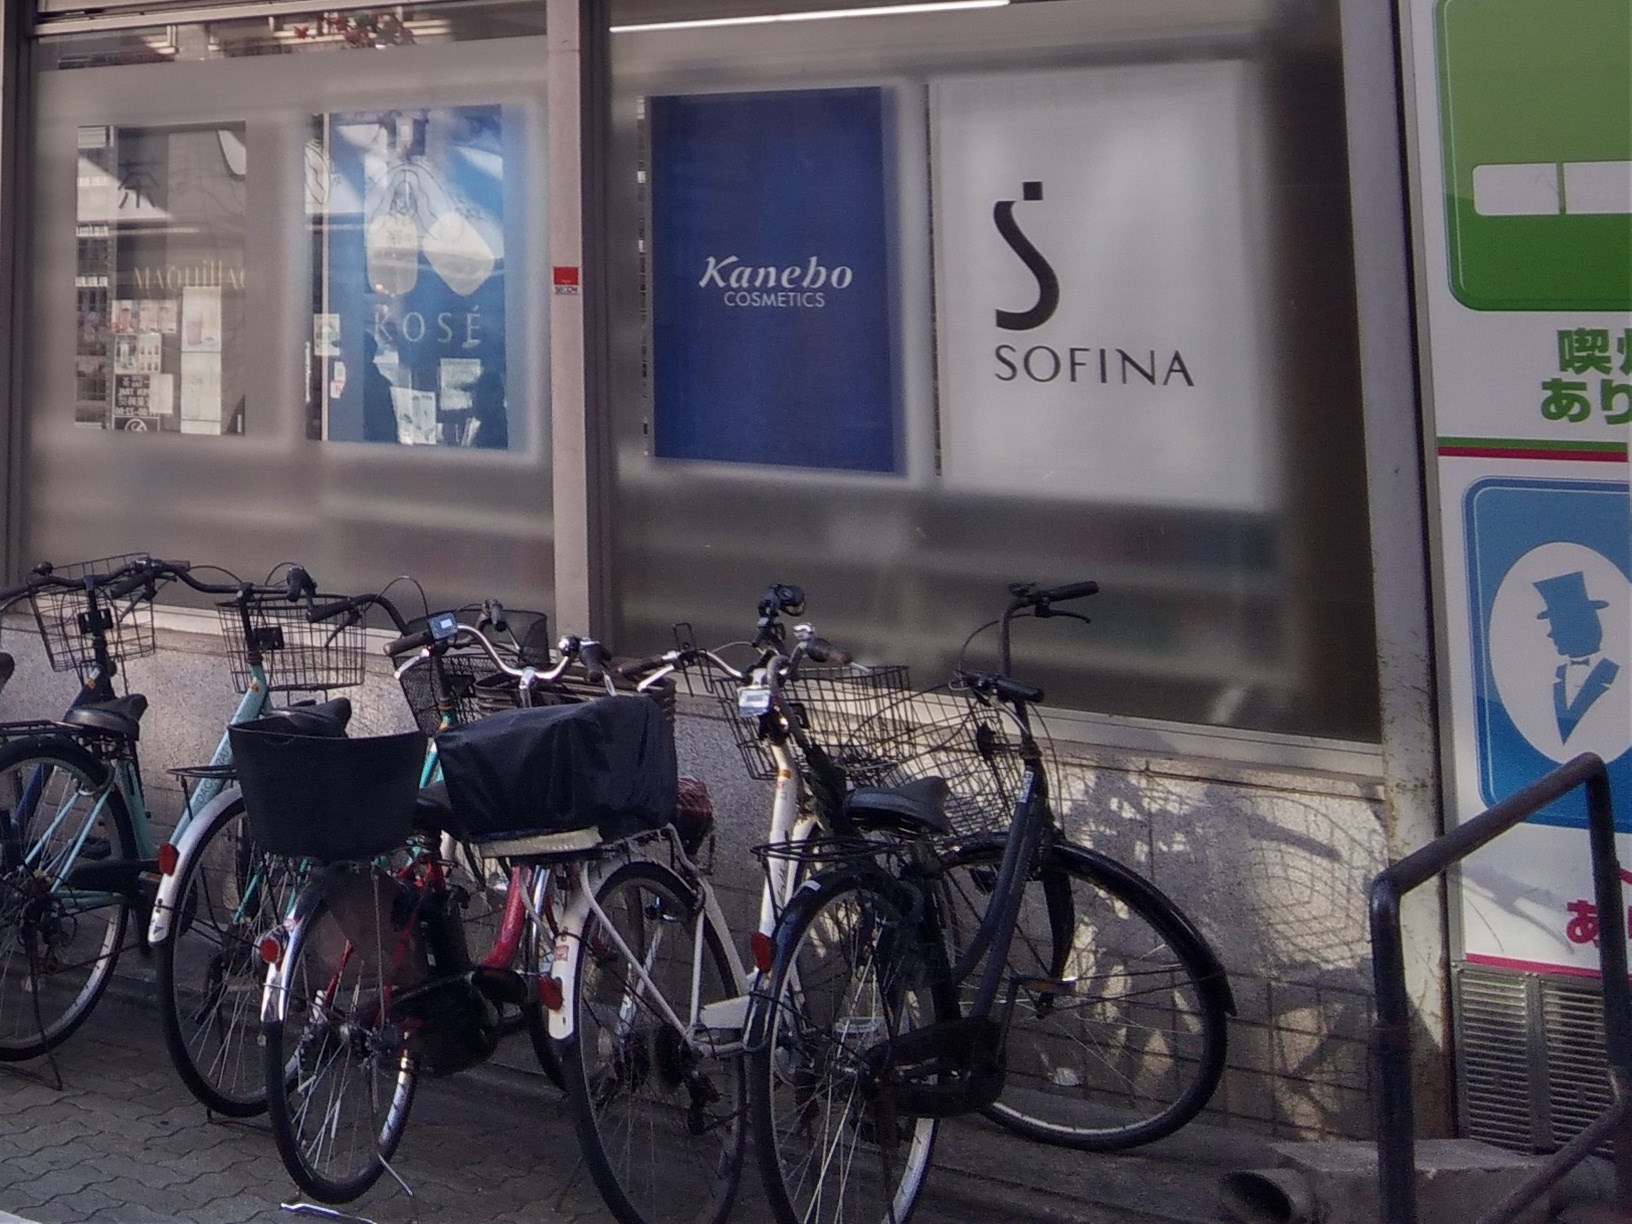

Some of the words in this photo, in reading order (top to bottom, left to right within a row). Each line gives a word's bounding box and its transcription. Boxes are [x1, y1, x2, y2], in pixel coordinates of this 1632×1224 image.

[698, 255, 853, 292] Kanebo
[724, 289, 826, 309] COSMETICS
[373, 305, 484, 348] KOSÉ
[994, 344, 1196, 388] SOFINA
[1557, 326, 1632, 375] 喫
